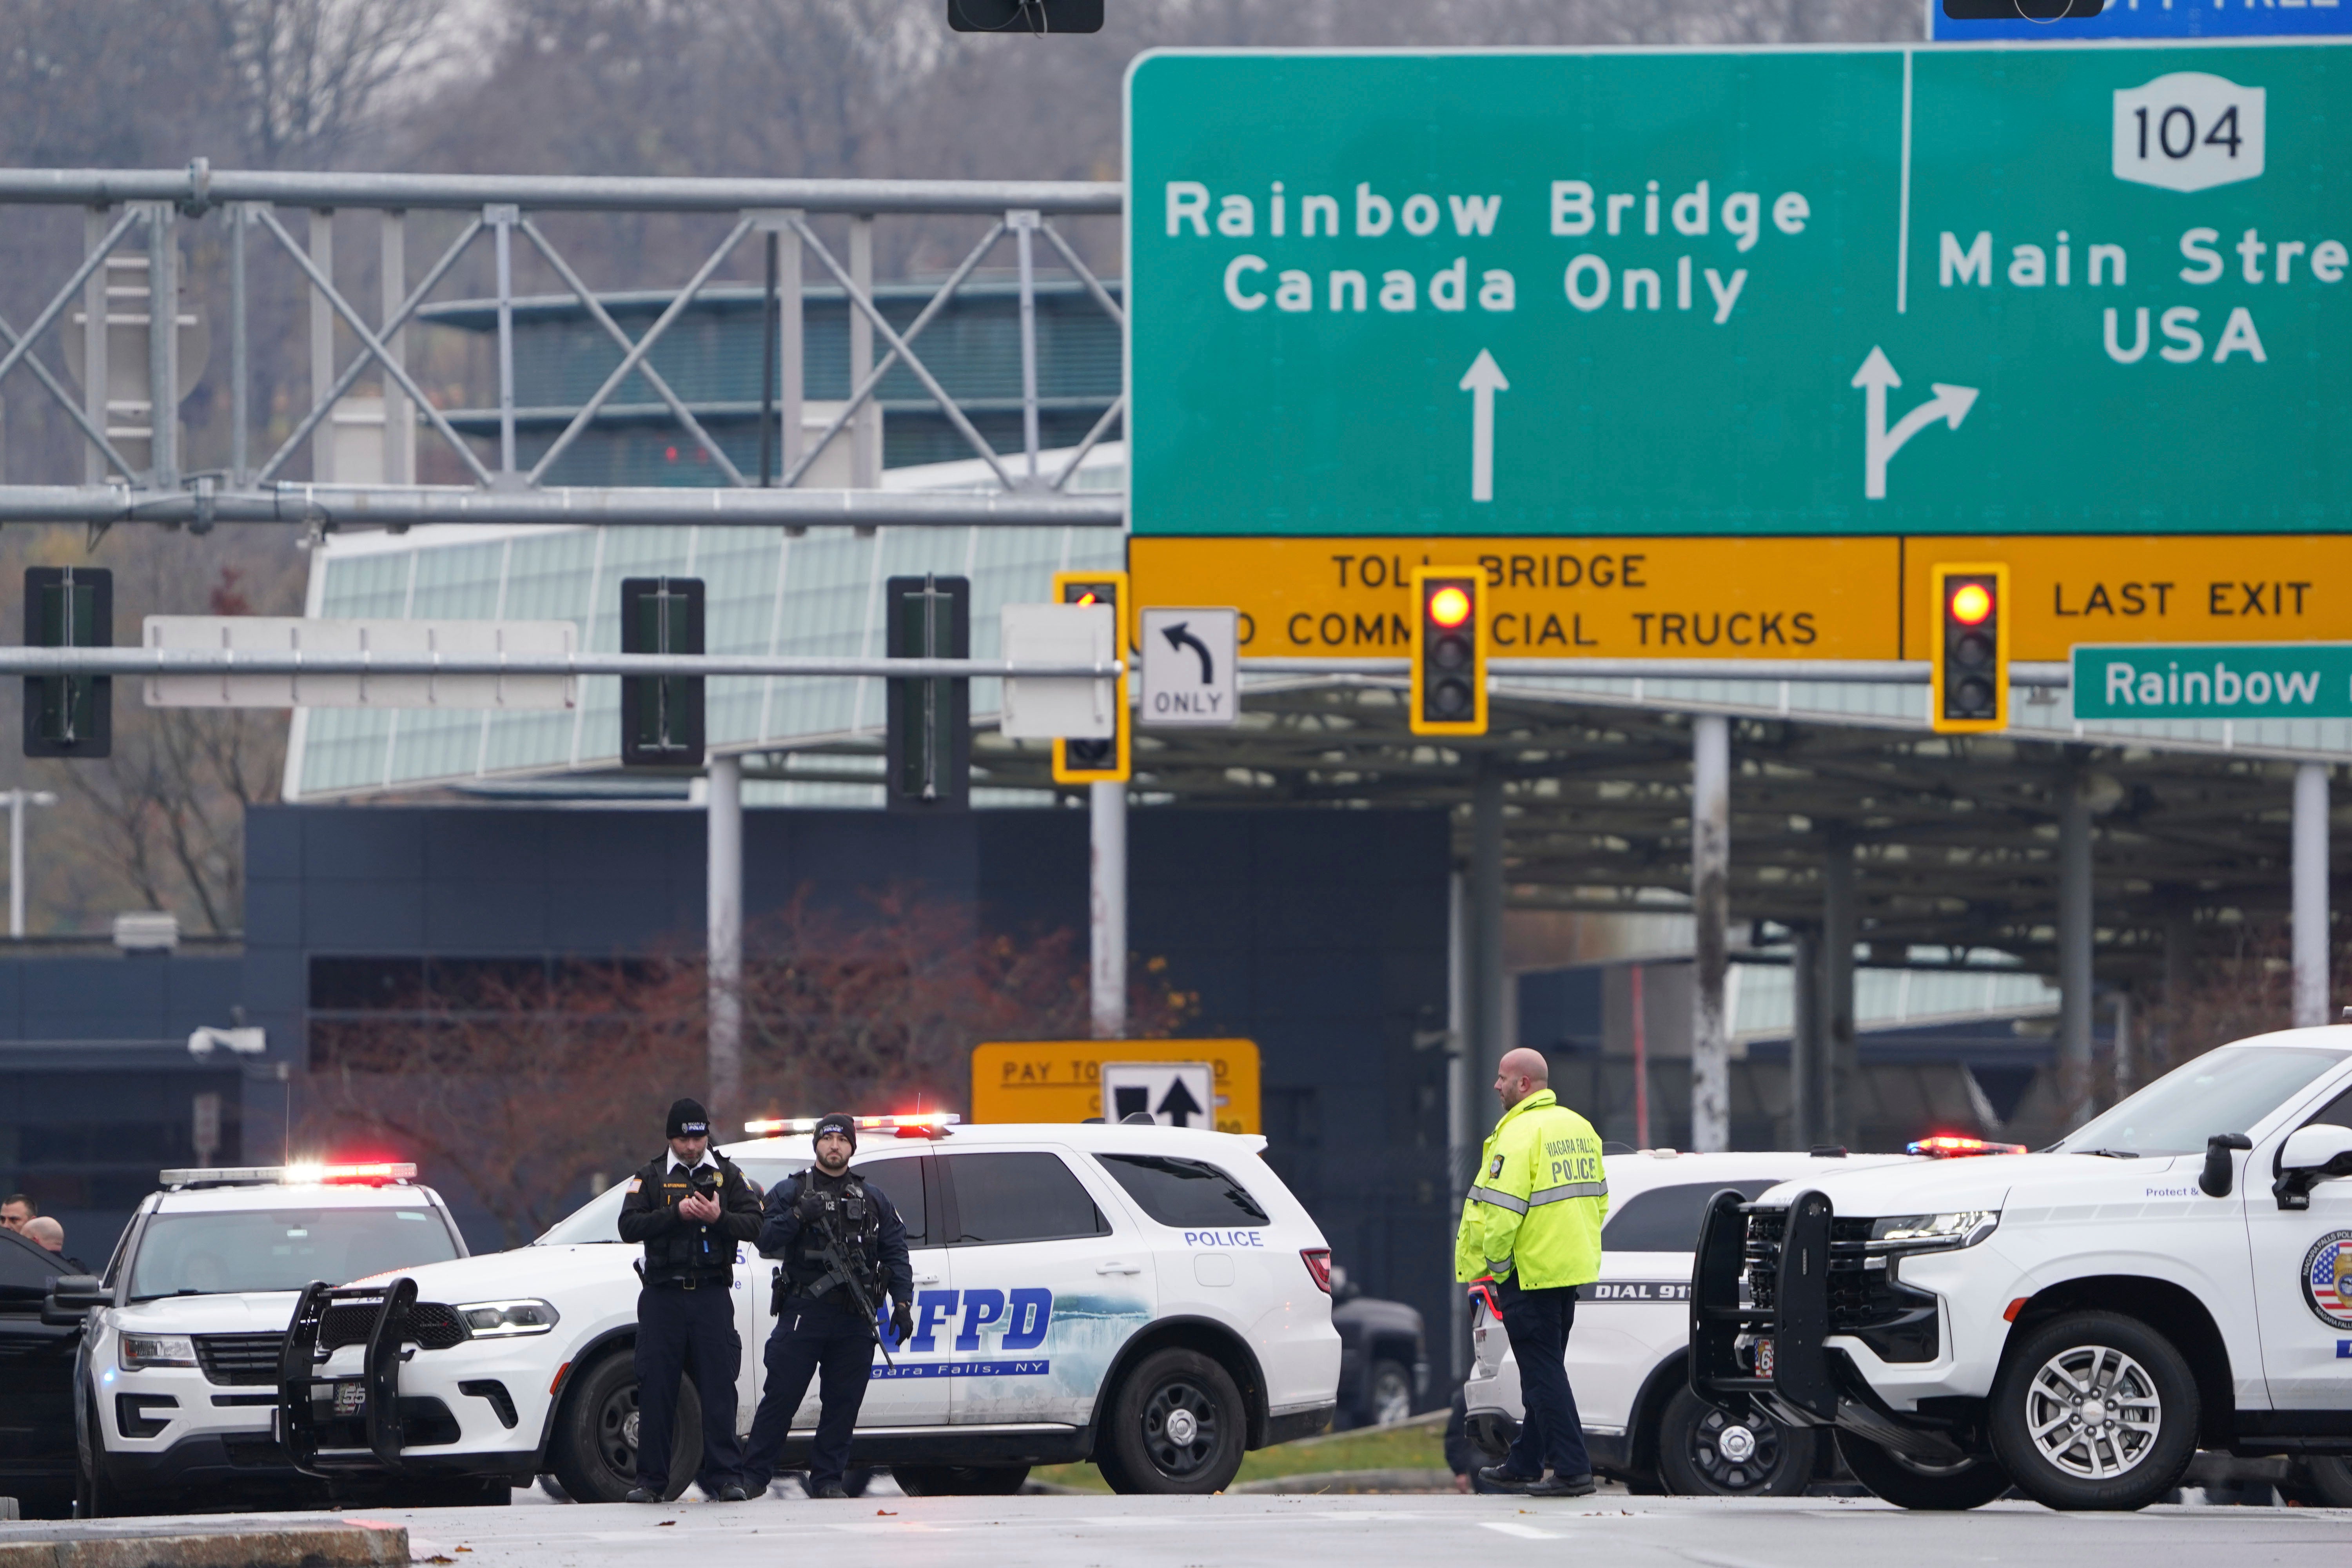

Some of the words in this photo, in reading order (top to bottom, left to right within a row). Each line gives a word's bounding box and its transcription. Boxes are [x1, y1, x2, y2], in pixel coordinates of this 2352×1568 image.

[2134, 105, 2243, 160] 104
[1166, 181, 1502, 236] Rainbow
[1551, 180, 1810, 253] Bridge
[1939, 230, 2127, 286] Main
[1223, 254, 1515, 311] Canada
[1564, 254, 1748, 325] Only
[2103, 306, 2267, 364] USA
[1332, 555, 1431, 588] TOL
[1479, 555, 1646, 588] BRIDGE
[2054, 582, 2174, 617] LAST
[2209, 582, 2311, 617] EXIT
[1632, 613, 1818, 646] TRUCKS
[2106, 662, 2320, 704] Rainbow
[1154, 691, 1223, 713] ONLY
[1003, 1061, 1051, 1081] PAY
[1552, 1158, 1595, 1183] POLICE
[2146, 1188, 2187, 1196] Protect
[1184, 1231, 1264, 1247] POLICE
[2303, 1246, 2320, 1276] NIAGARA
[2317, 1232, 2336, 1249] FALLS
[1595, 1285, 1651, 1298] DIAL
[2337, 1321, 2352, 1329] FALL
[938, 1364, 999, 1375] Falls,
[1015, 1362, 1043, 1372] NY
[343, 1387, 365, 1405] 55
